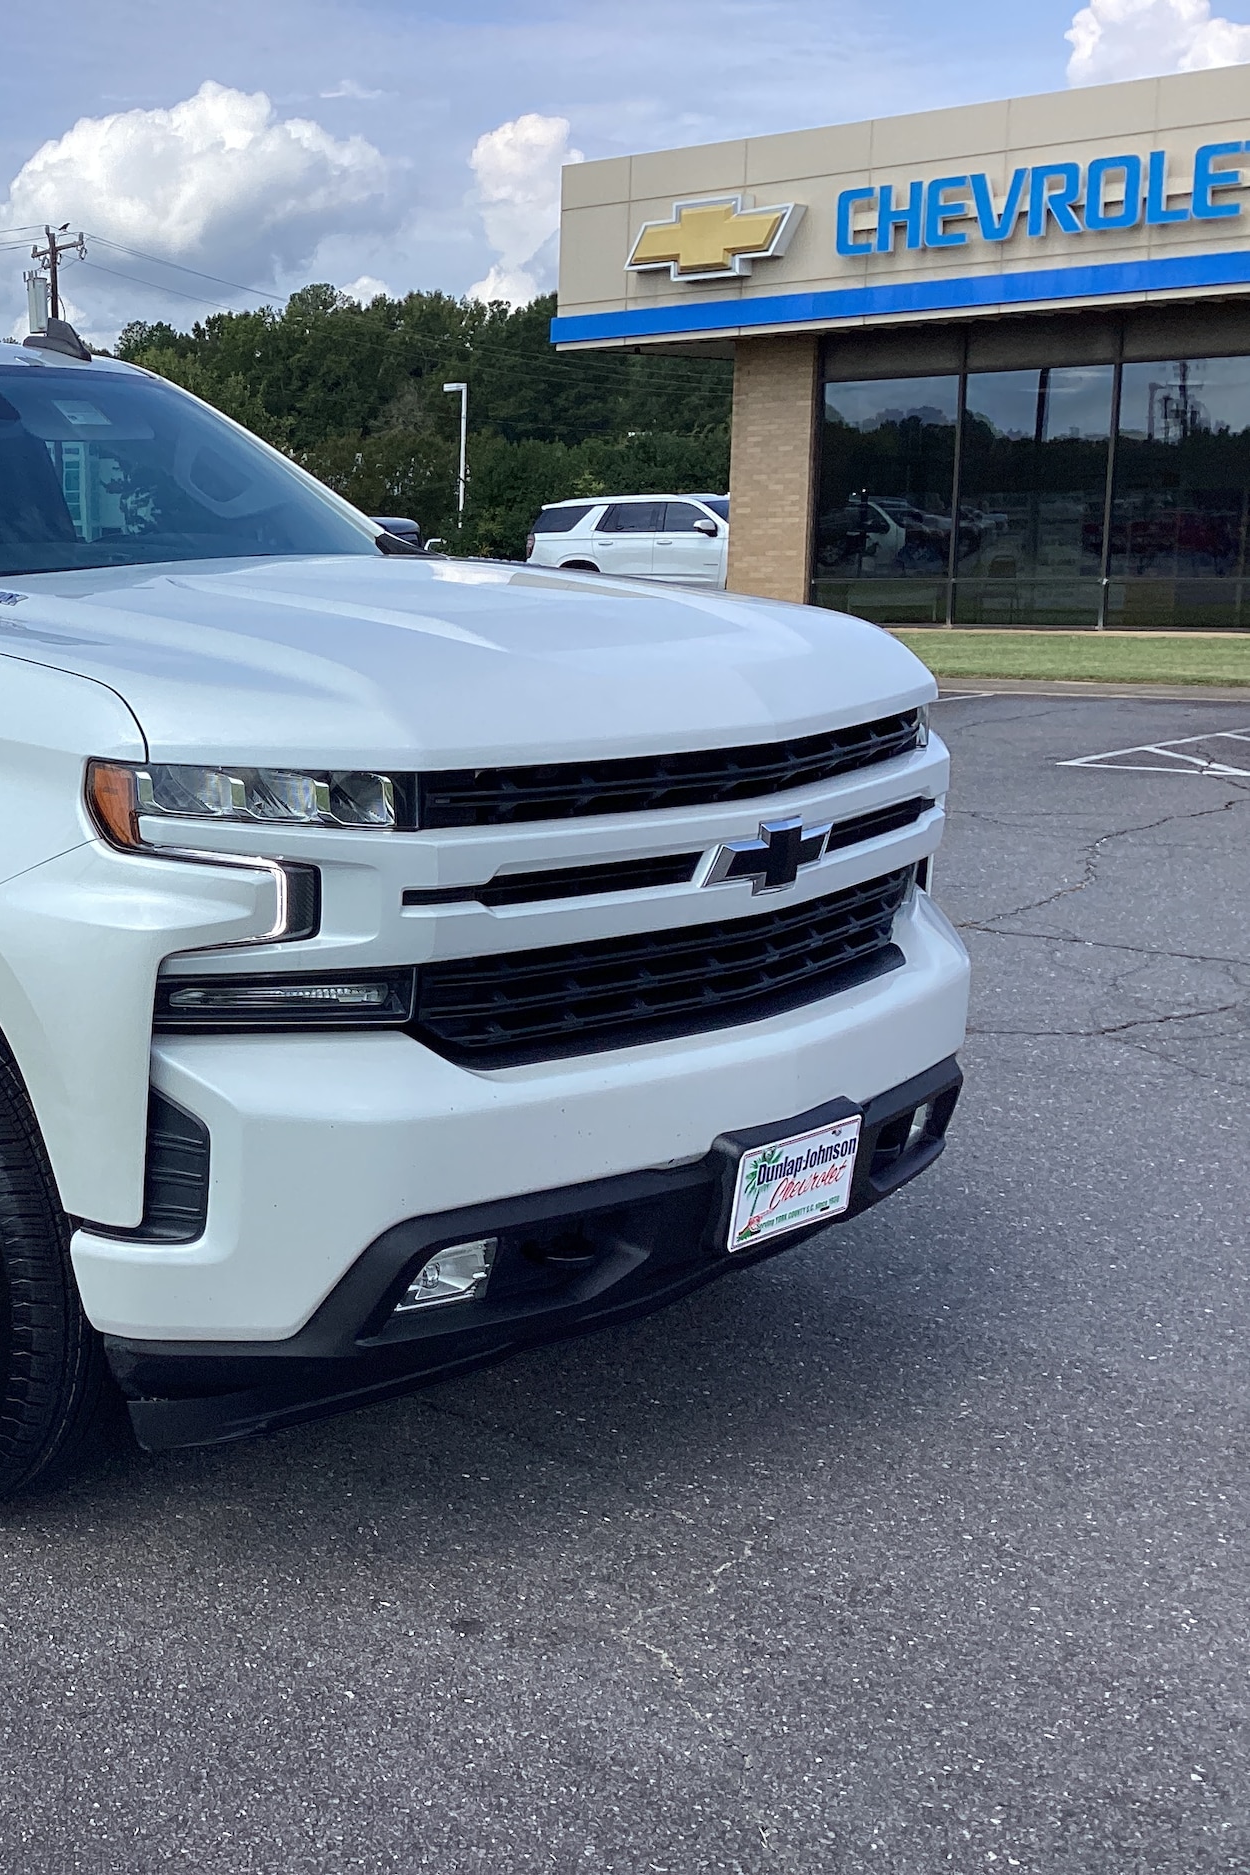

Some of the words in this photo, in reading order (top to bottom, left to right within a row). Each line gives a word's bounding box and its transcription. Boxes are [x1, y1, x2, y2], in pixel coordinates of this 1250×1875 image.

[836, 140, 1250, 257] CHEVROLE
[769, 1160, 847, 1210] Chevrolet
[788, 1207, 805, 1219] COUNTY
